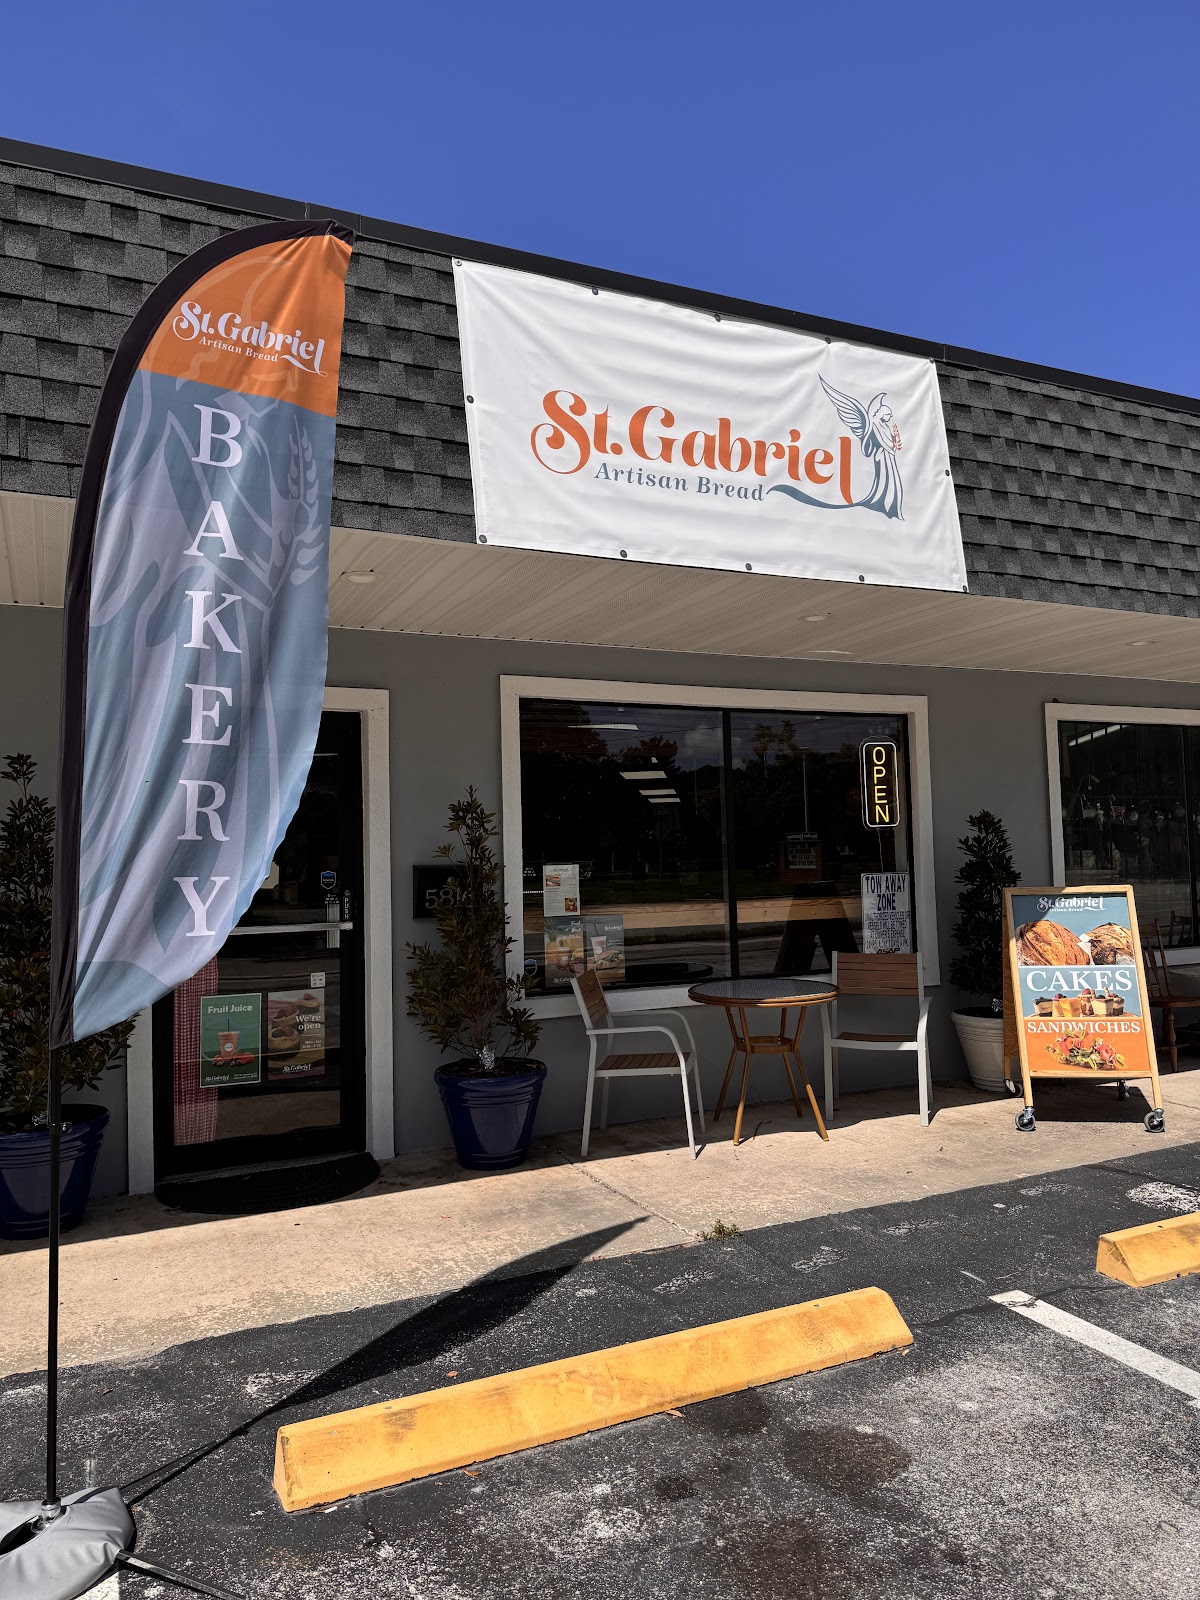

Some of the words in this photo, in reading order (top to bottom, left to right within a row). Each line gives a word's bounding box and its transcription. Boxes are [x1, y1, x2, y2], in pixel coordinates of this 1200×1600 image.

[199, 336, 242, 355] Artisan
[245, 347, 279, 363] Bread
[593, 462, 689, 492] Artisan
[696, 475, 766, 502] Bread
[173, 403, 243, 937] BAKERY
[872, 746, 890, 823] OPEN
[865, 875, 882, 894] TOW
[885, 874, 906, 893] AWAY
[877, 893, 896, 912] ZONE
[1026, 969, 1132, 991] CAKES
[207, 1005, 229, 1014] Fruit
[230, 1004, 253, 1013] Juice
[295, 1013, 321, 1023] We're
[298, 1021, 321, 1032] open
[1027, 1021, 1141, 1034] SANDWICHES
